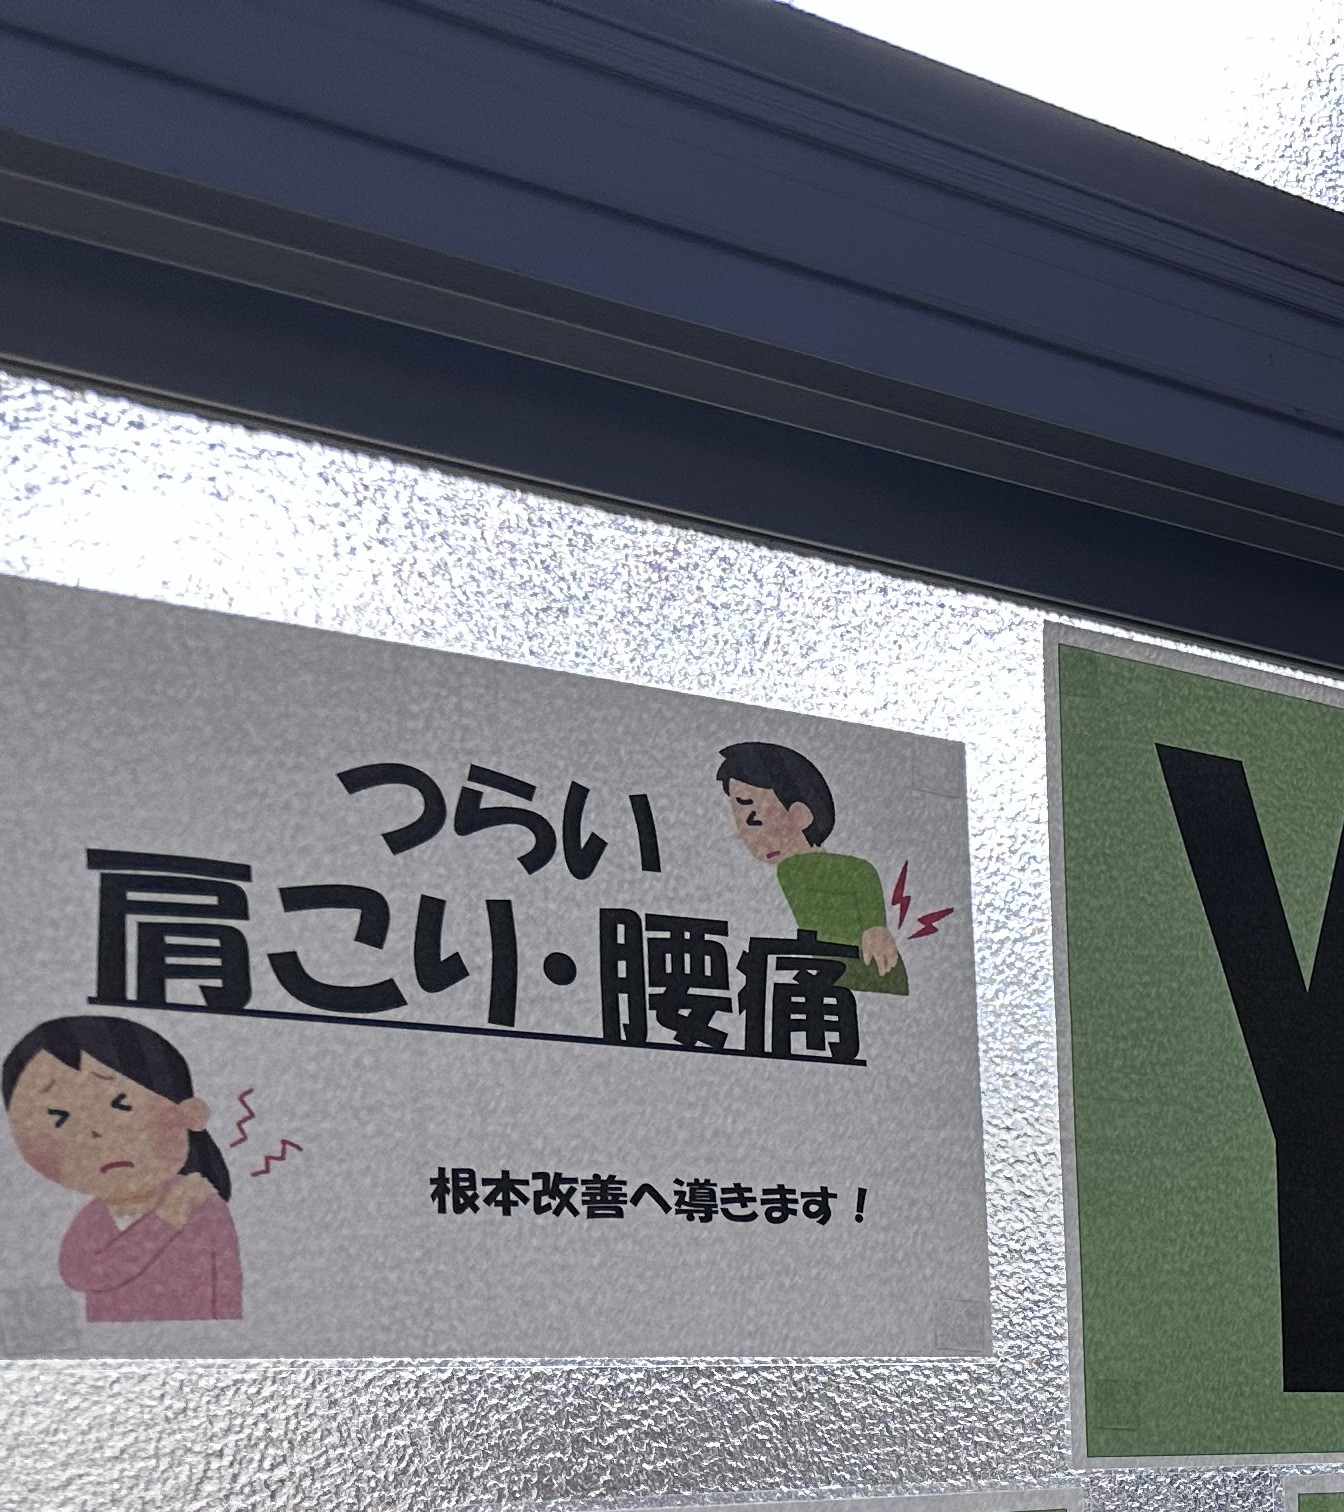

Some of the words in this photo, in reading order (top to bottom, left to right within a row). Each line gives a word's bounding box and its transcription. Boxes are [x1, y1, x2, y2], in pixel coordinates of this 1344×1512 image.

[336, 761, 662, 880] つらい
[85, 847, 867, 1064] 肩こり・腰痛
[429, 1167, 868, 1226] 根本改善へ導きます！
